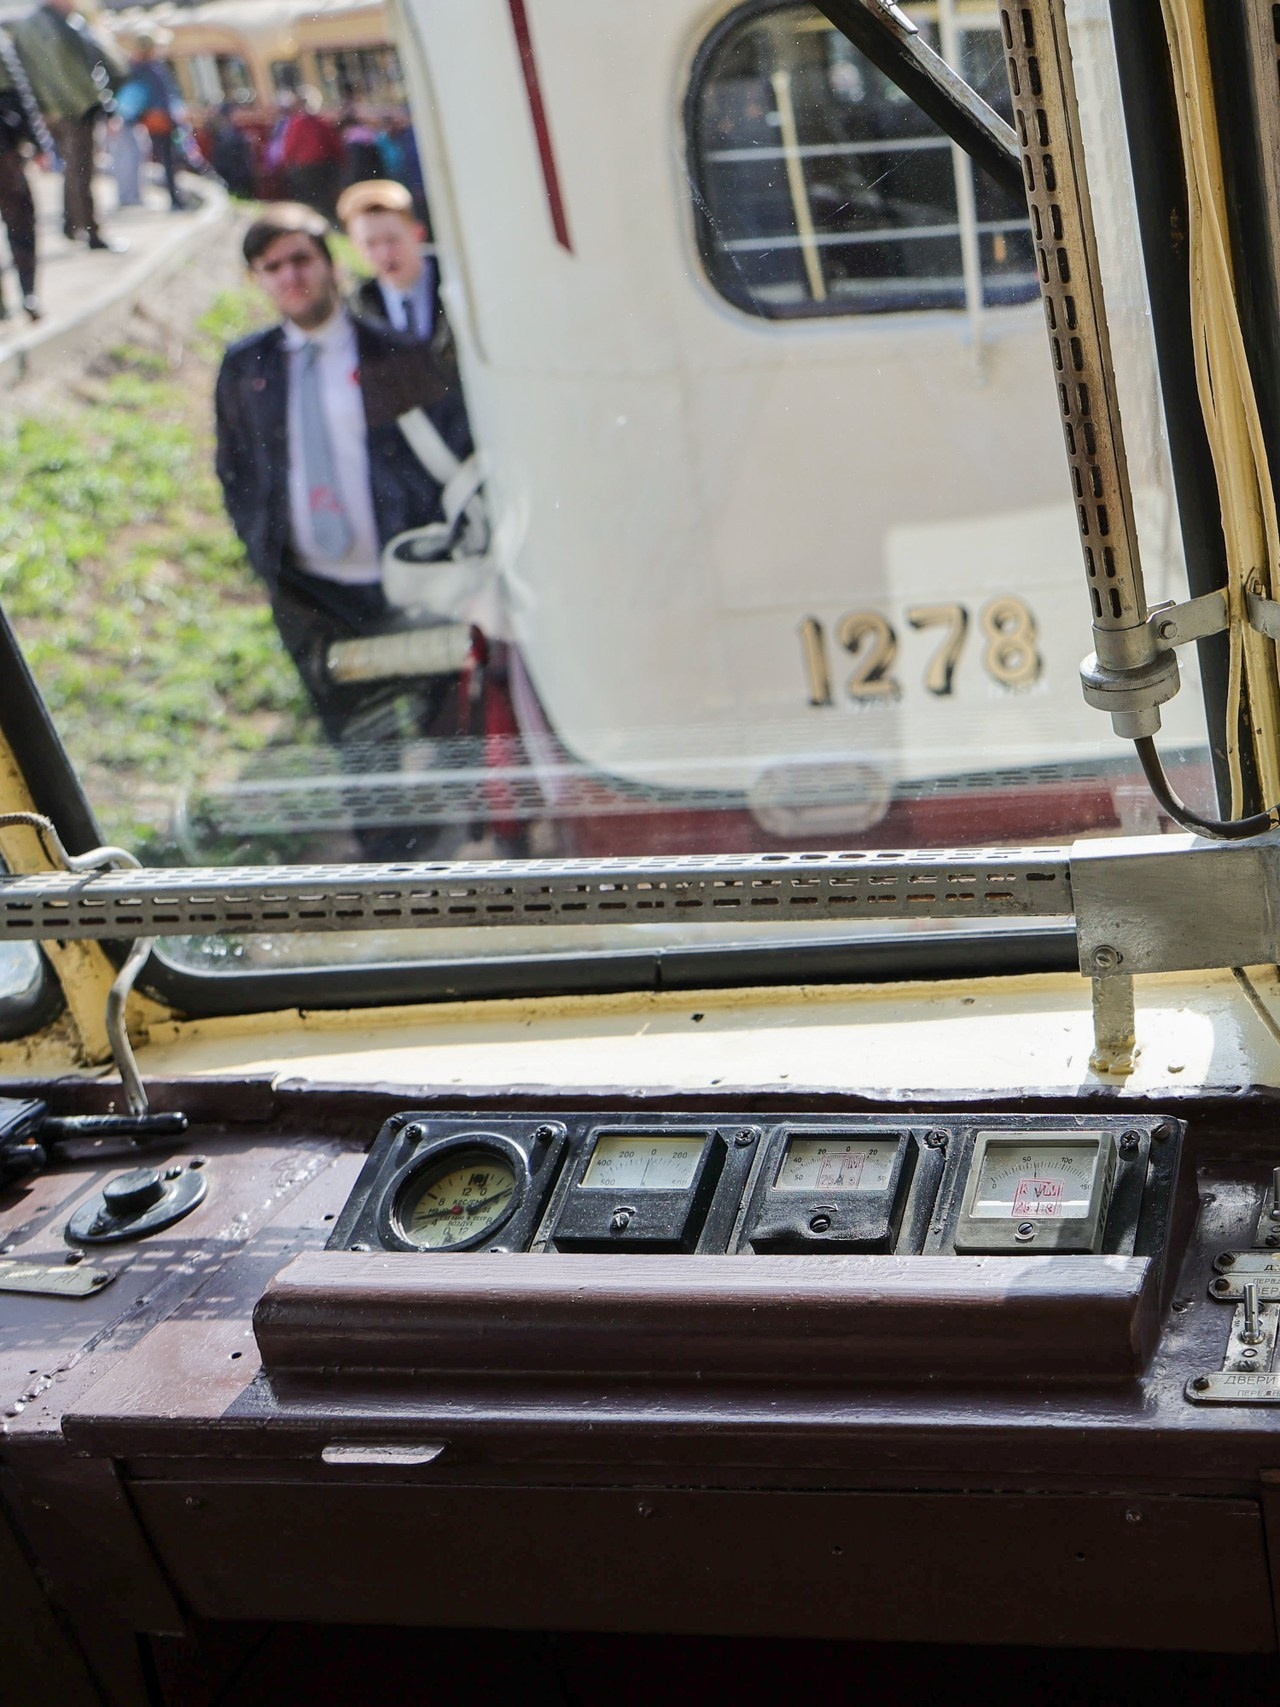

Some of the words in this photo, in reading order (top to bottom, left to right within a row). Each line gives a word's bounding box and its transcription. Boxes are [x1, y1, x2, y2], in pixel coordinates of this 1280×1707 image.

[802, 595, 1042, 706] 1278
[651, 1148, 657, 1156] 0
[672, 1151, 688, 1159] 200
[845, 1145, 851, 1153] 0
[868, 1148, 878, 1156] 20
[596, 1159, 612, 1167] 400
[1022, 1155, 1032, 1163] 50
[1060, 1156, 1073, 1165] 100
[794, 1173, 804, 1181] 50
[600, 1178, 616, 1186] 500
[461, 1187, 472, 1196] 12
[479, 1187, 487, 1196] 0
[438, 1197, 446, 1206] 8
[431, 1218, 438, 1226] 4
[1224, 1375, 1276, 1385] ДВЕРИ
